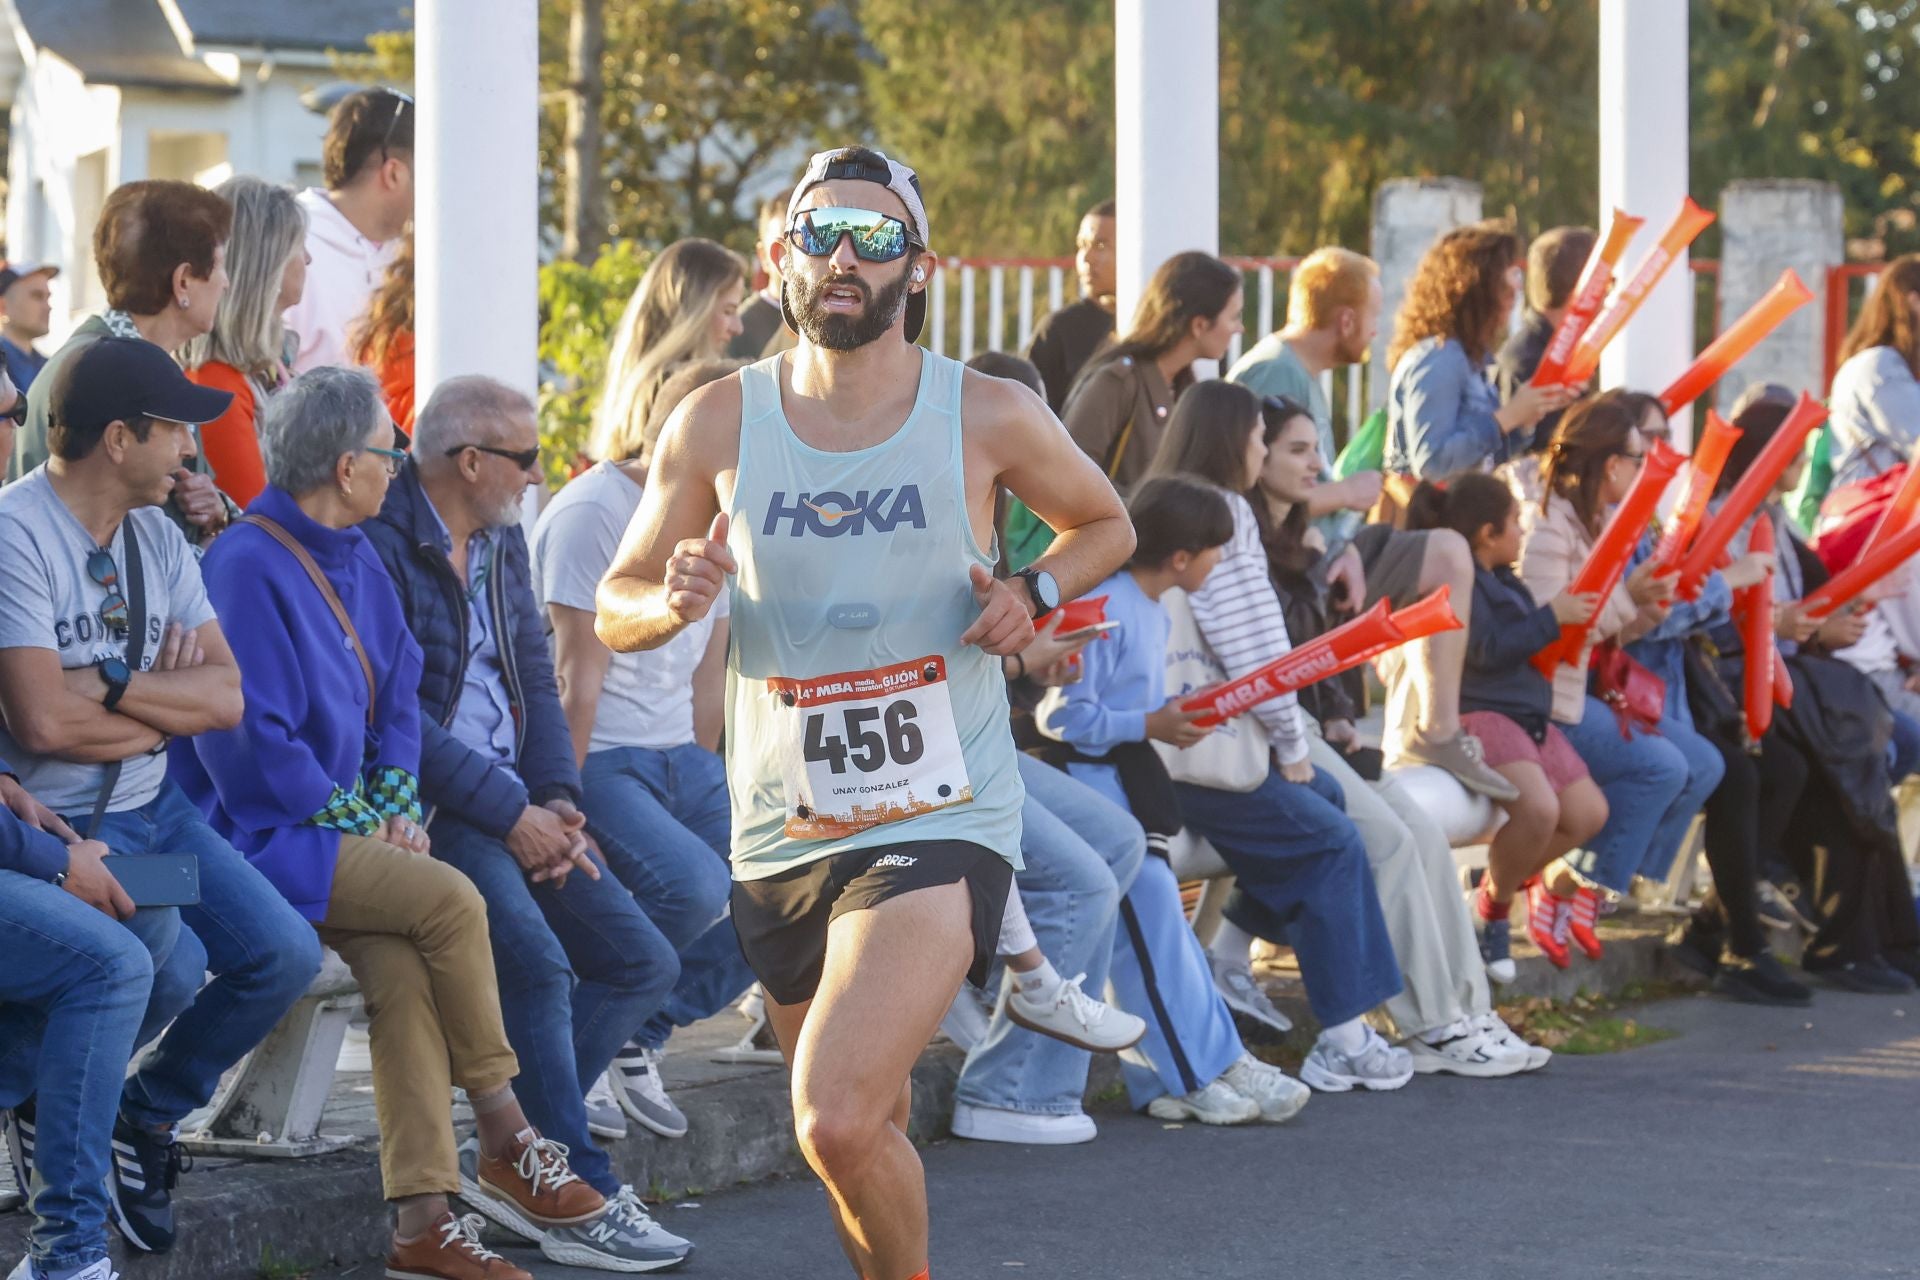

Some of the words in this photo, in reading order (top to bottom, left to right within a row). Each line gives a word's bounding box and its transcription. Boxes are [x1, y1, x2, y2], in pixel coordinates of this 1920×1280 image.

[762, 484, 927, 538] HOKA
[855, 679, 876, 687] media
[855, 683, 883, 692] maratón
[882, 669, 919, 688] GIJÓN
[816, 681, 853, 698] MBA
[1214, 675, 1275, 716] MBA
[803, 699, 925, 775] 456
[832, 786, 857, 795] UNAY
[859, 778, 910, 794] GONZALEZ
